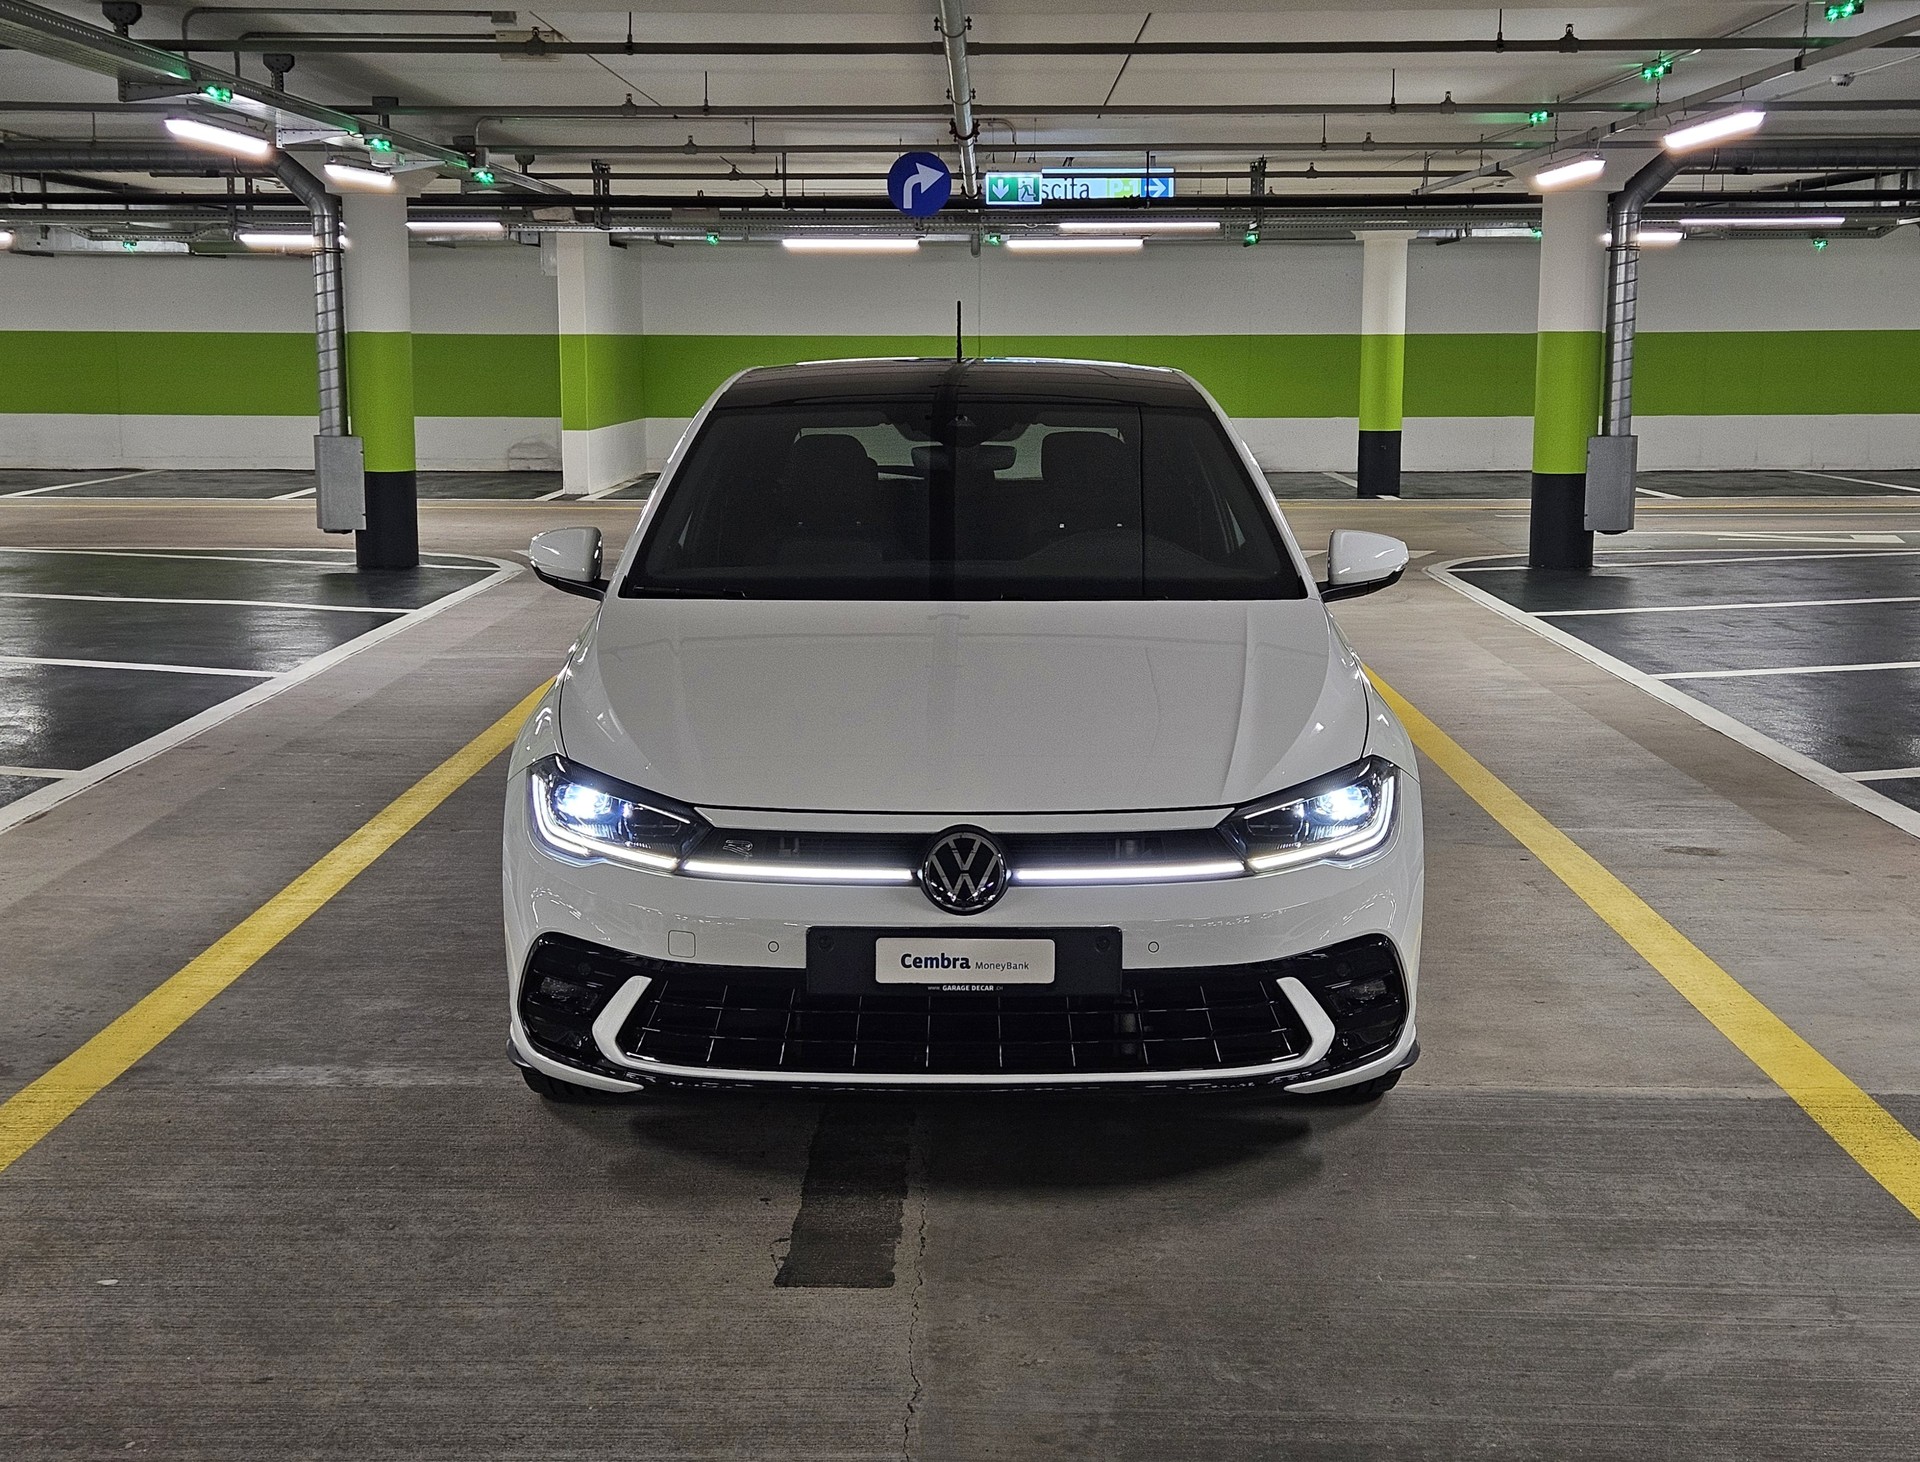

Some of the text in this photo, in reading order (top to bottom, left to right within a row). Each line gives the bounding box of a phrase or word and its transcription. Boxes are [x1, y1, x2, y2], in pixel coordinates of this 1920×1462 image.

[1042, 178, 1090, 199] scita
[900, 953, 1030, 971] Cembra MoneyBank
